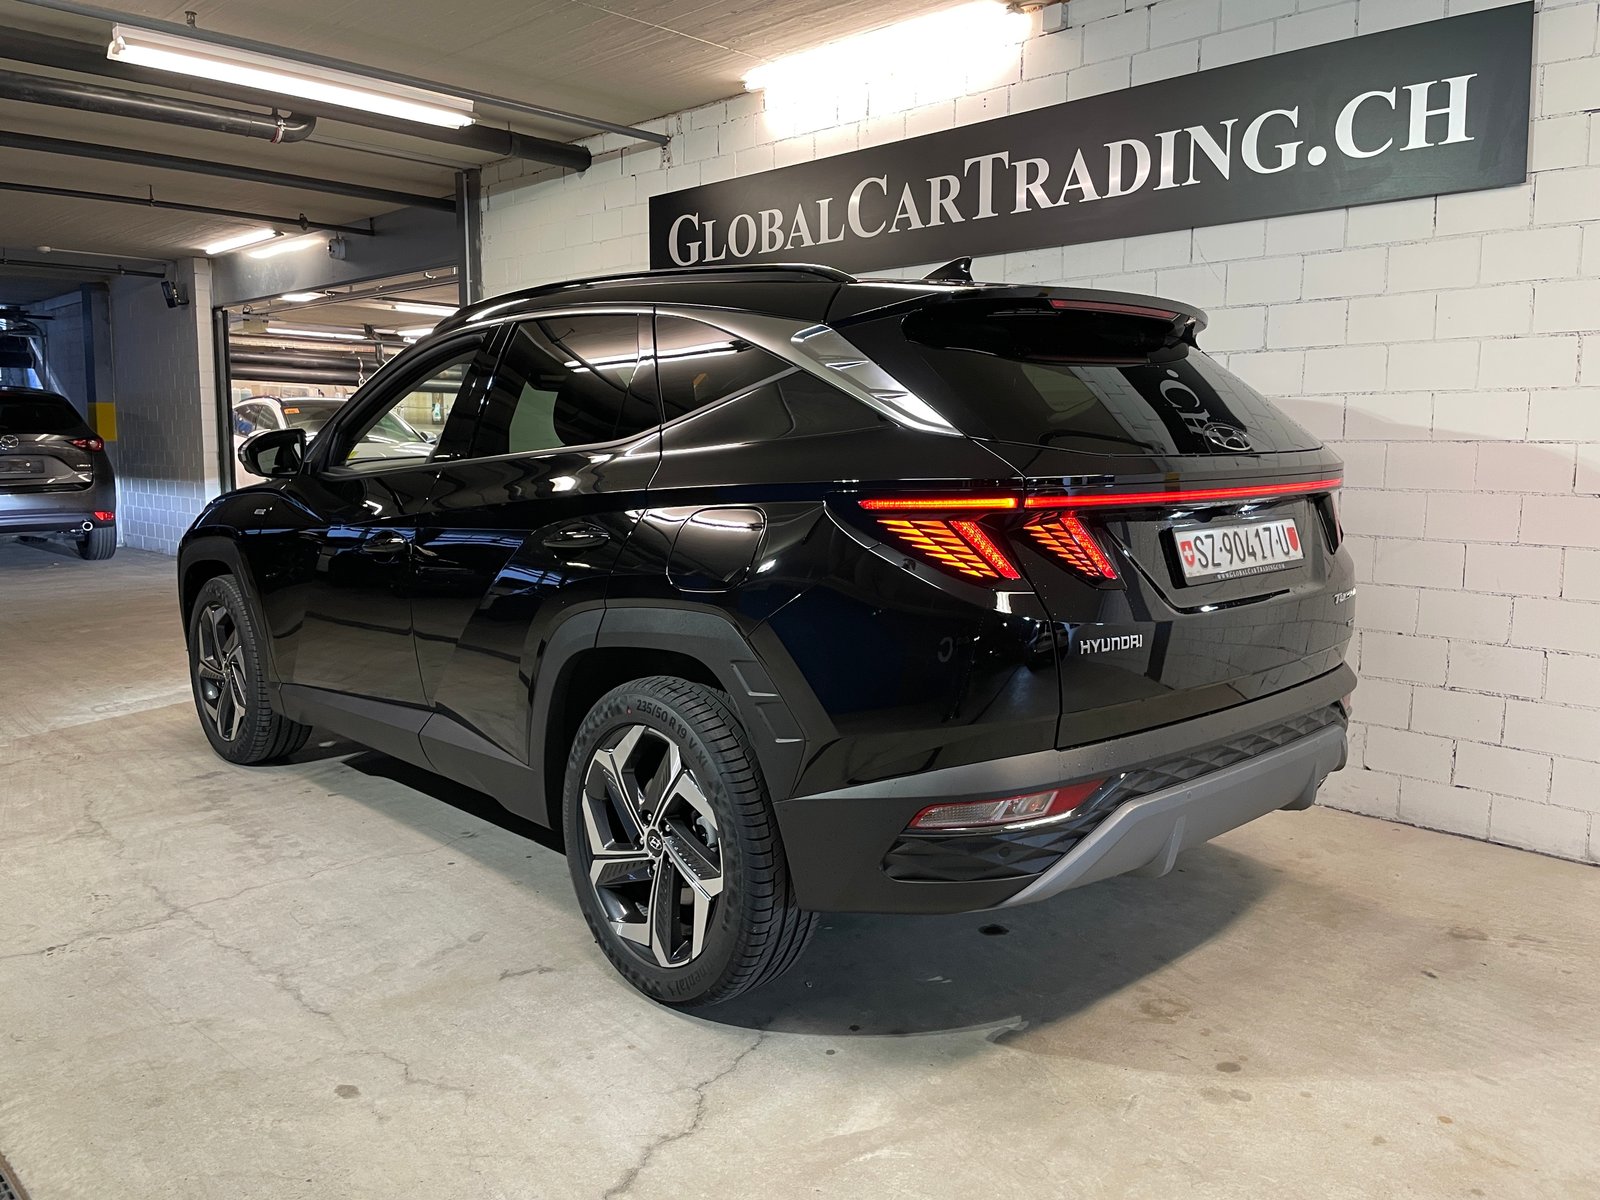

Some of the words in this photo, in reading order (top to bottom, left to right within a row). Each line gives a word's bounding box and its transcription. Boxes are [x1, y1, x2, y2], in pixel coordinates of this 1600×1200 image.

[1079, 634, 1143, 655] HYUNDAI
[636, 699, 669, 723] 235/50
[668, 716, 677, 730] R
[677, 724, 688, 739] 19
